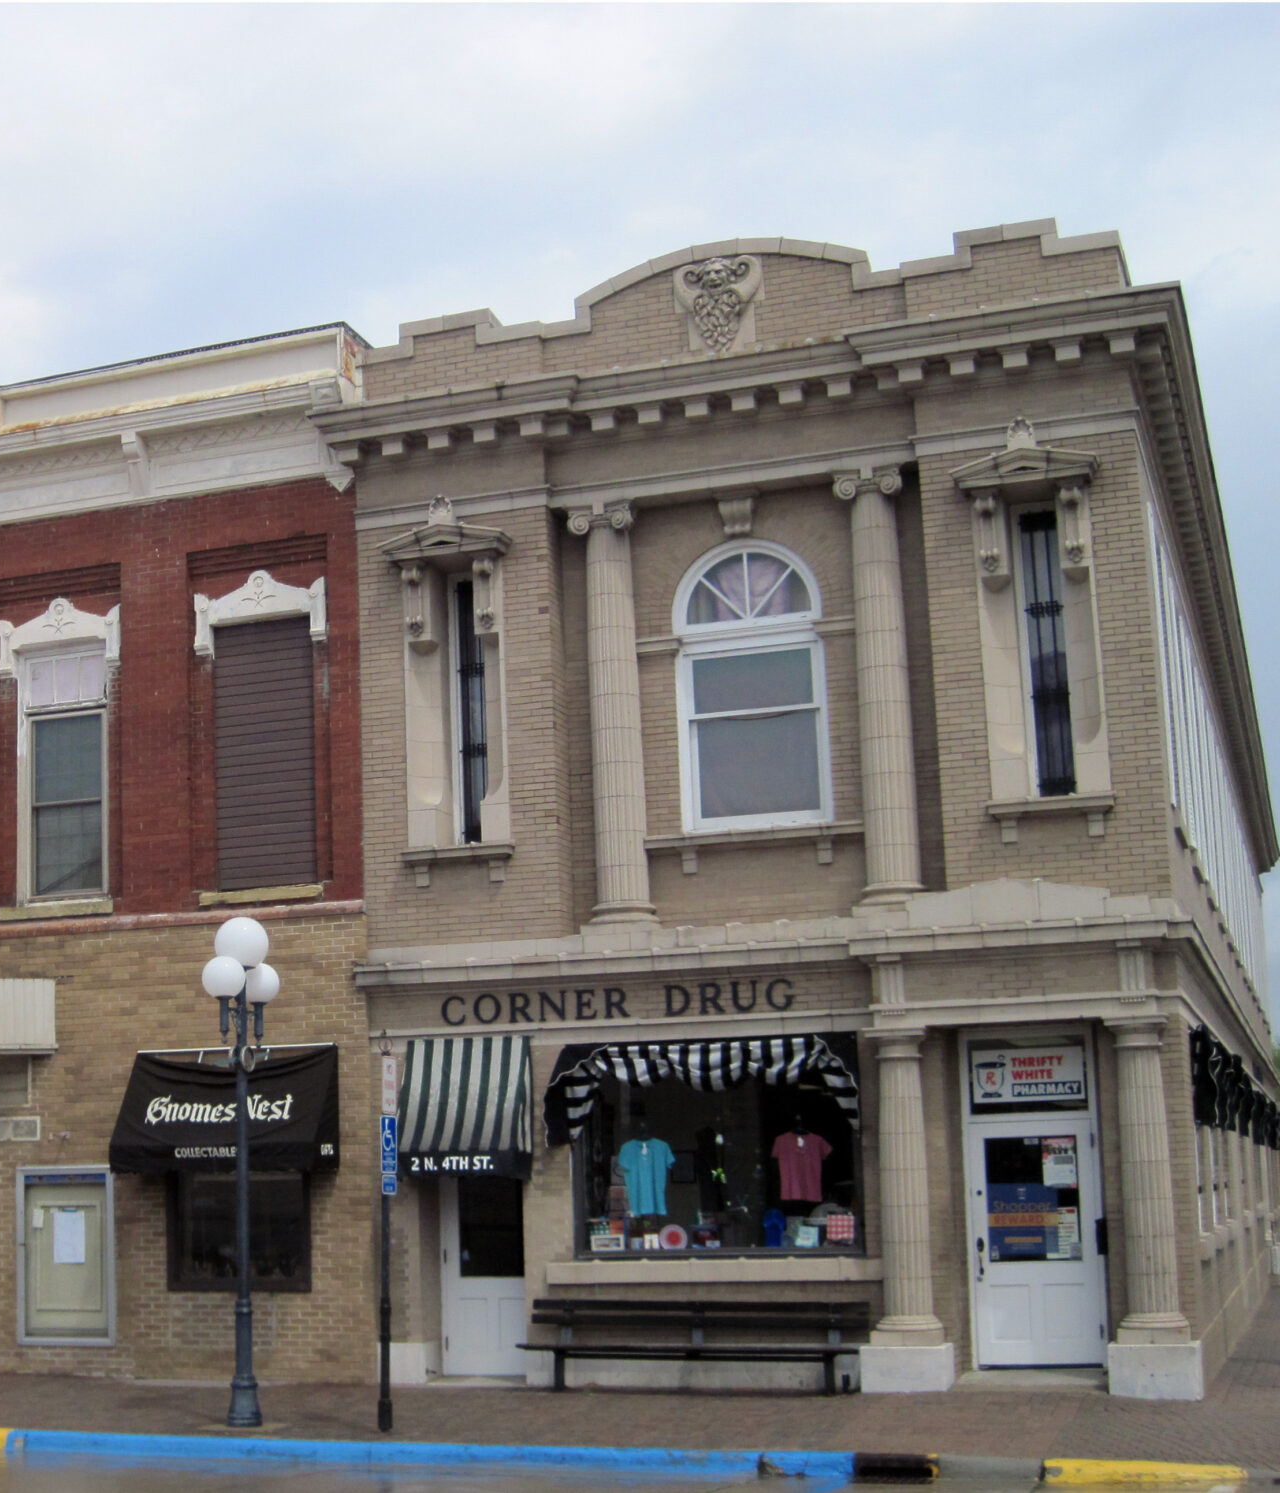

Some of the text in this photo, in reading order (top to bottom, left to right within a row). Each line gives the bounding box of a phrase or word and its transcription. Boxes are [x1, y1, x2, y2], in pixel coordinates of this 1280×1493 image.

[440, 978, 796, 1026] CORNER DRUG
[1010, 1055, 1064, 1068] THRIFTY
[1011, 1068, 1053, 1080] WHITE
[1012, 1082, 1079, 1096] PHARMACY
[144, 1094, 238, 1126] Gnomes
[411, 1157, 420, 1171] 2
[424, 1156, 438, 1171] N.
[442, 1156, 469, 1170] 4TH
[472, 1155, 494, 1170] ST.
